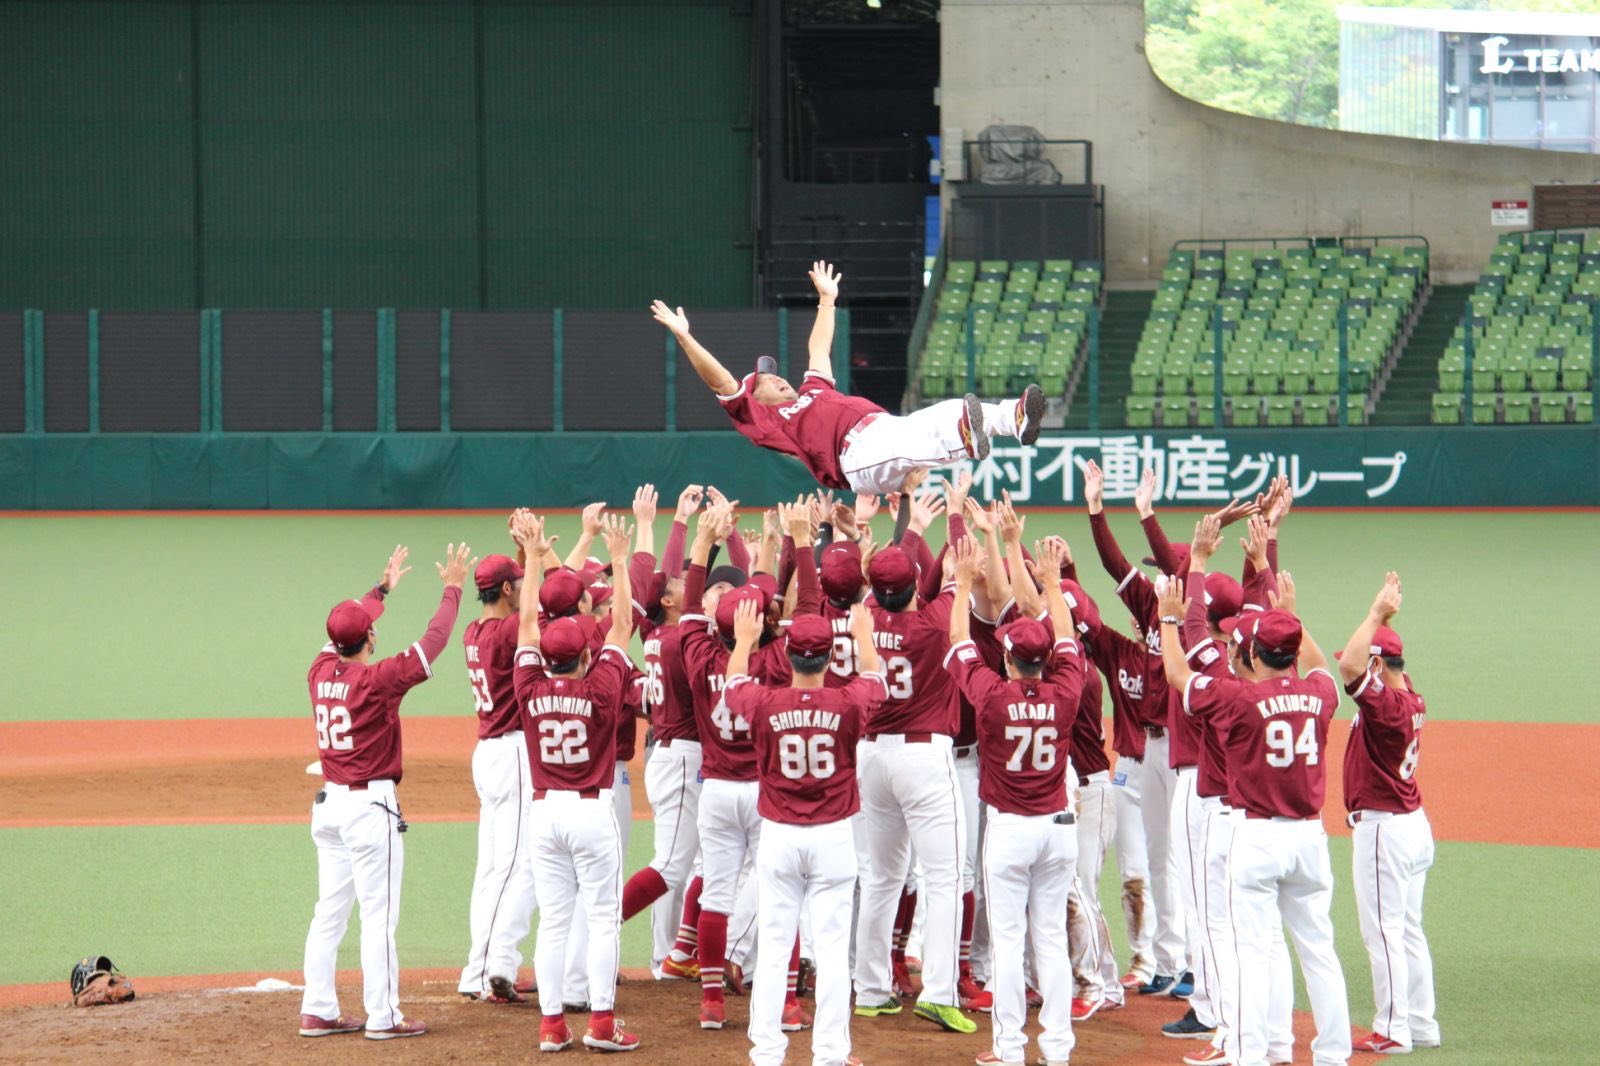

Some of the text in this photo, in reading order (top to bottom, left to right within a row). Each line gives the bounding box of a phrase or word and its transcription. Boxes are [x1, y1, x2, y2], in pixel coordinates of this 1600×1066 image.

[315, 704, 354, 751] 82
[528, 694, 593, 718] KAWASHIMA
[768, 709, 842, 732] SHIOKAWA
[1008, 702, 1056, 722] OKADA
[1256, 698, 1323, 719] KAKIUCHI
[538, 719, 591, 765] 22
[777, 733, 836, 780] 86
[1004, 726, 1058, 772] 76
[1265, 720, 1319, 768] 94
